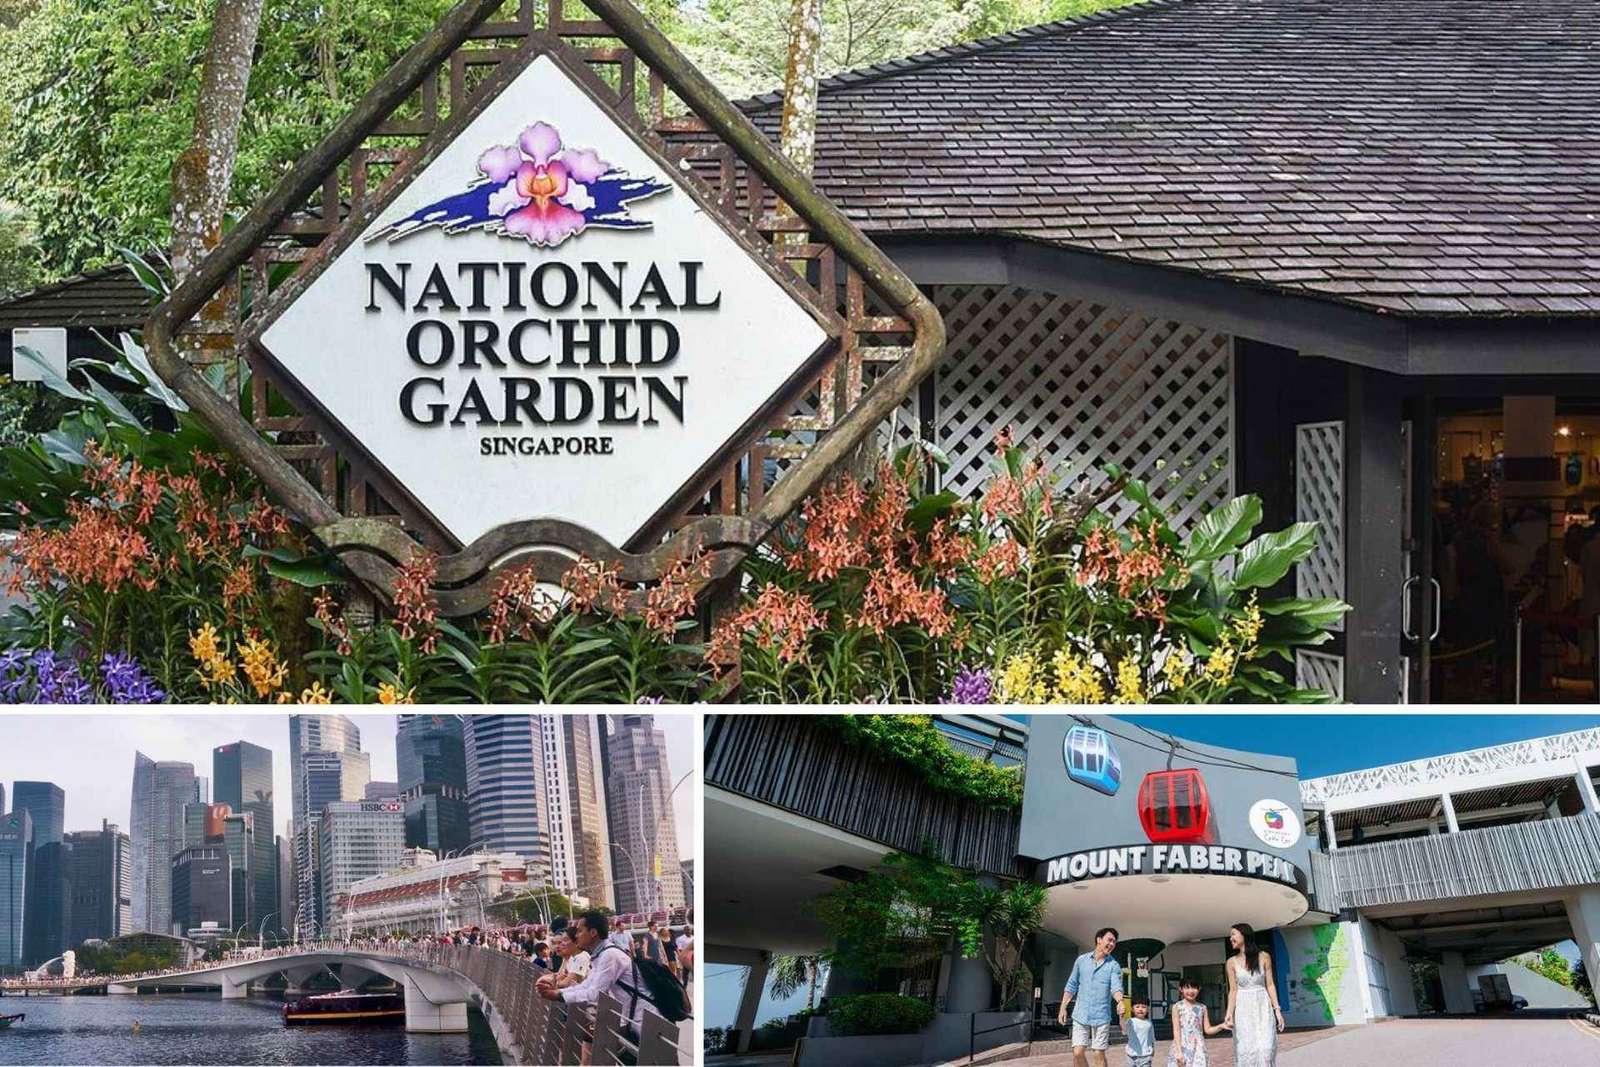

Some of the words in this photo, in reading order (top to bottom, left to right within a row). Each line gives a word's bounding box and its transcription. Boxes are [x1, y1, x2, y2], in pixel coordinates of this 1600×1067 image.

[364, 261, 722, 312] NATIONAL
[405, 318, 681, 369] ORCHID
[398, 375, 689, 427] GARDEN
[480, 436, 614, 456] SINGAPORE
[360, 803, 386, 812] HSBC
[1047, 846, 1148, 884] MOUNT
[1153, 844, 1244, 873] FABER
